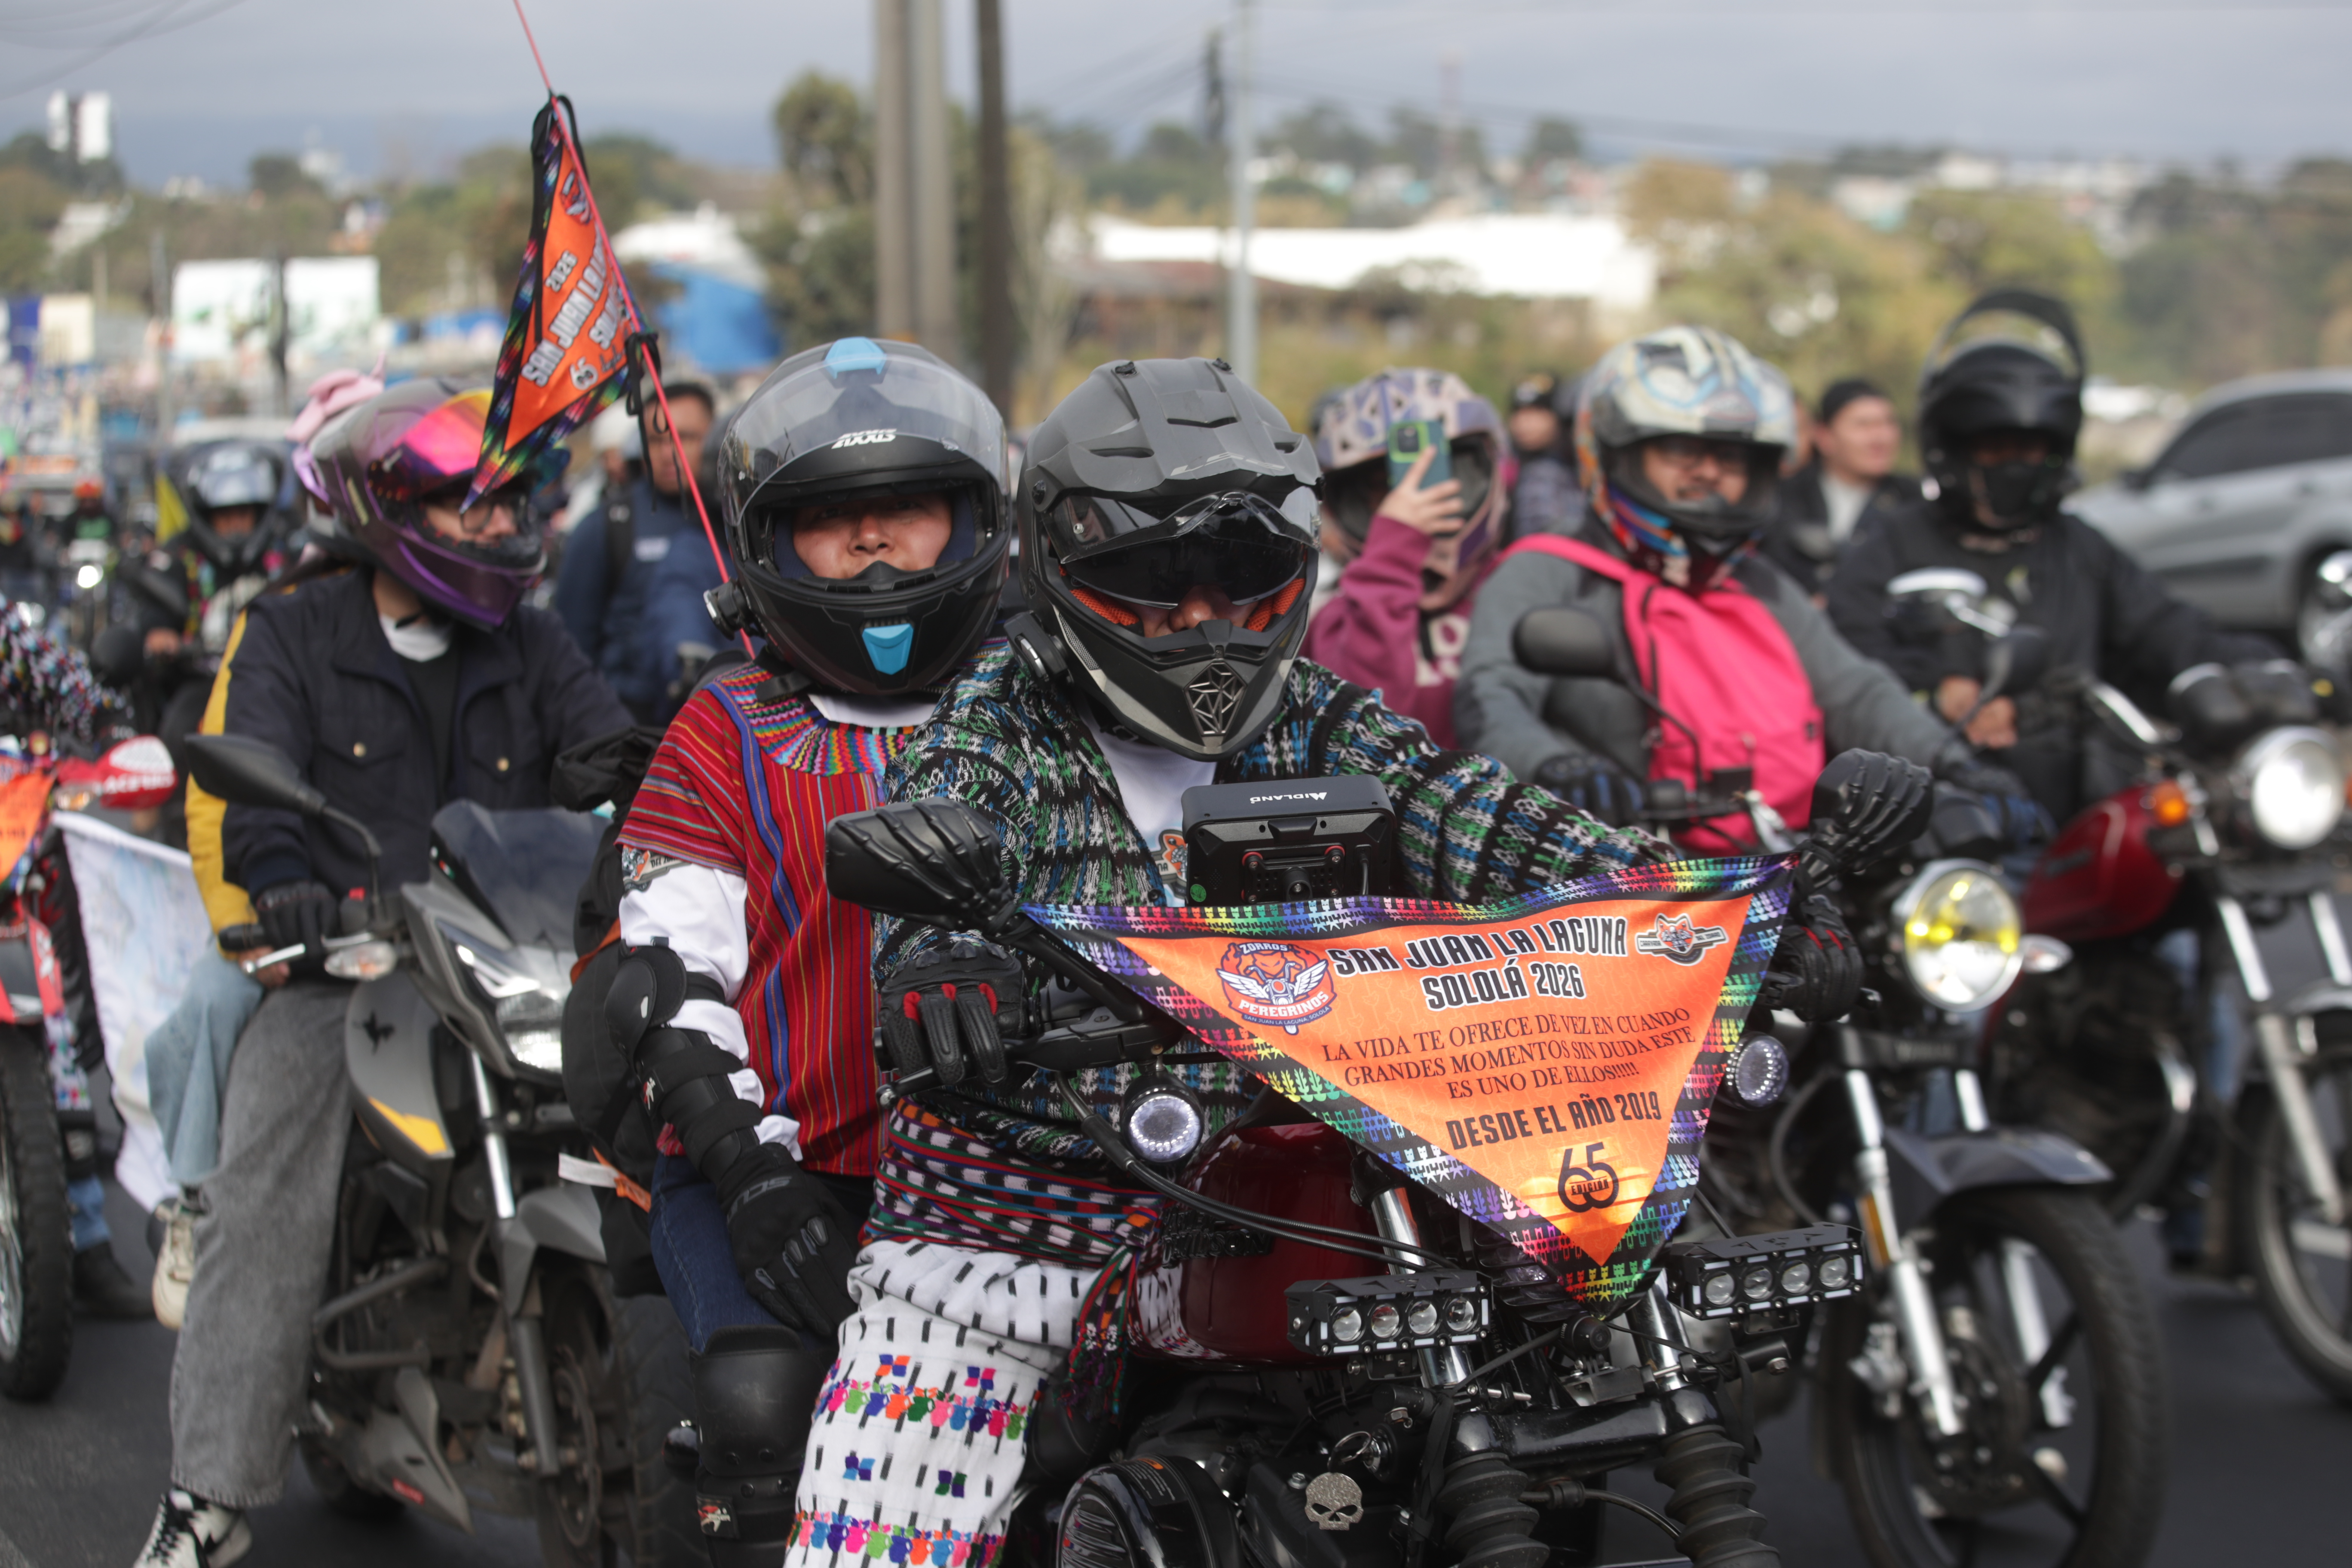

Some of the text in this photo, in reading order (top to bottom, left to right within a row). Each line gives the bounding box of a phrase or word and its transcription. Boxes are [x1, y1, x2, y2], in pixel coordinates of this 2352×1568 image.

[521, 338, 565, 388] SAN
[548, 284, 595, 350] JUAN
[570, 356, 600, 391] 65
[831, 428, 897, 450] AXXIS
[1250, 792, 1327, 803] MIDLAND
[1239, 943, 1288, 954] ZORROS
[1326, 916, 1629, 977] SAN JUAN LA LAGUNA
[1421, 958, 1587, 1011] SOLOLÁ 2026
[1238, 991, 1329, 1017] PEREGRINOS
[1243, 1014, 1257, 1022] SAN
[1322, 1008, 1690, 1062] LA VIDA TE OFRECE DE VEZ EN CUANDO
[1344, 1026, 1696, 1087] GRANDES MOMENTOS SIN DUDA ESTE
[1446, 1080, 1473, 1099] ES
[1476, 1072, 1527, 1095] UNO
[1531, 1067, 1567, 1088] DE
[1446, 1091, 1662, 1150] DESDE EL AÑO 2019
[1557, 1141, 1619, 1213] 65
[1570, 1178, 1610, 1195] EDICIÓN
